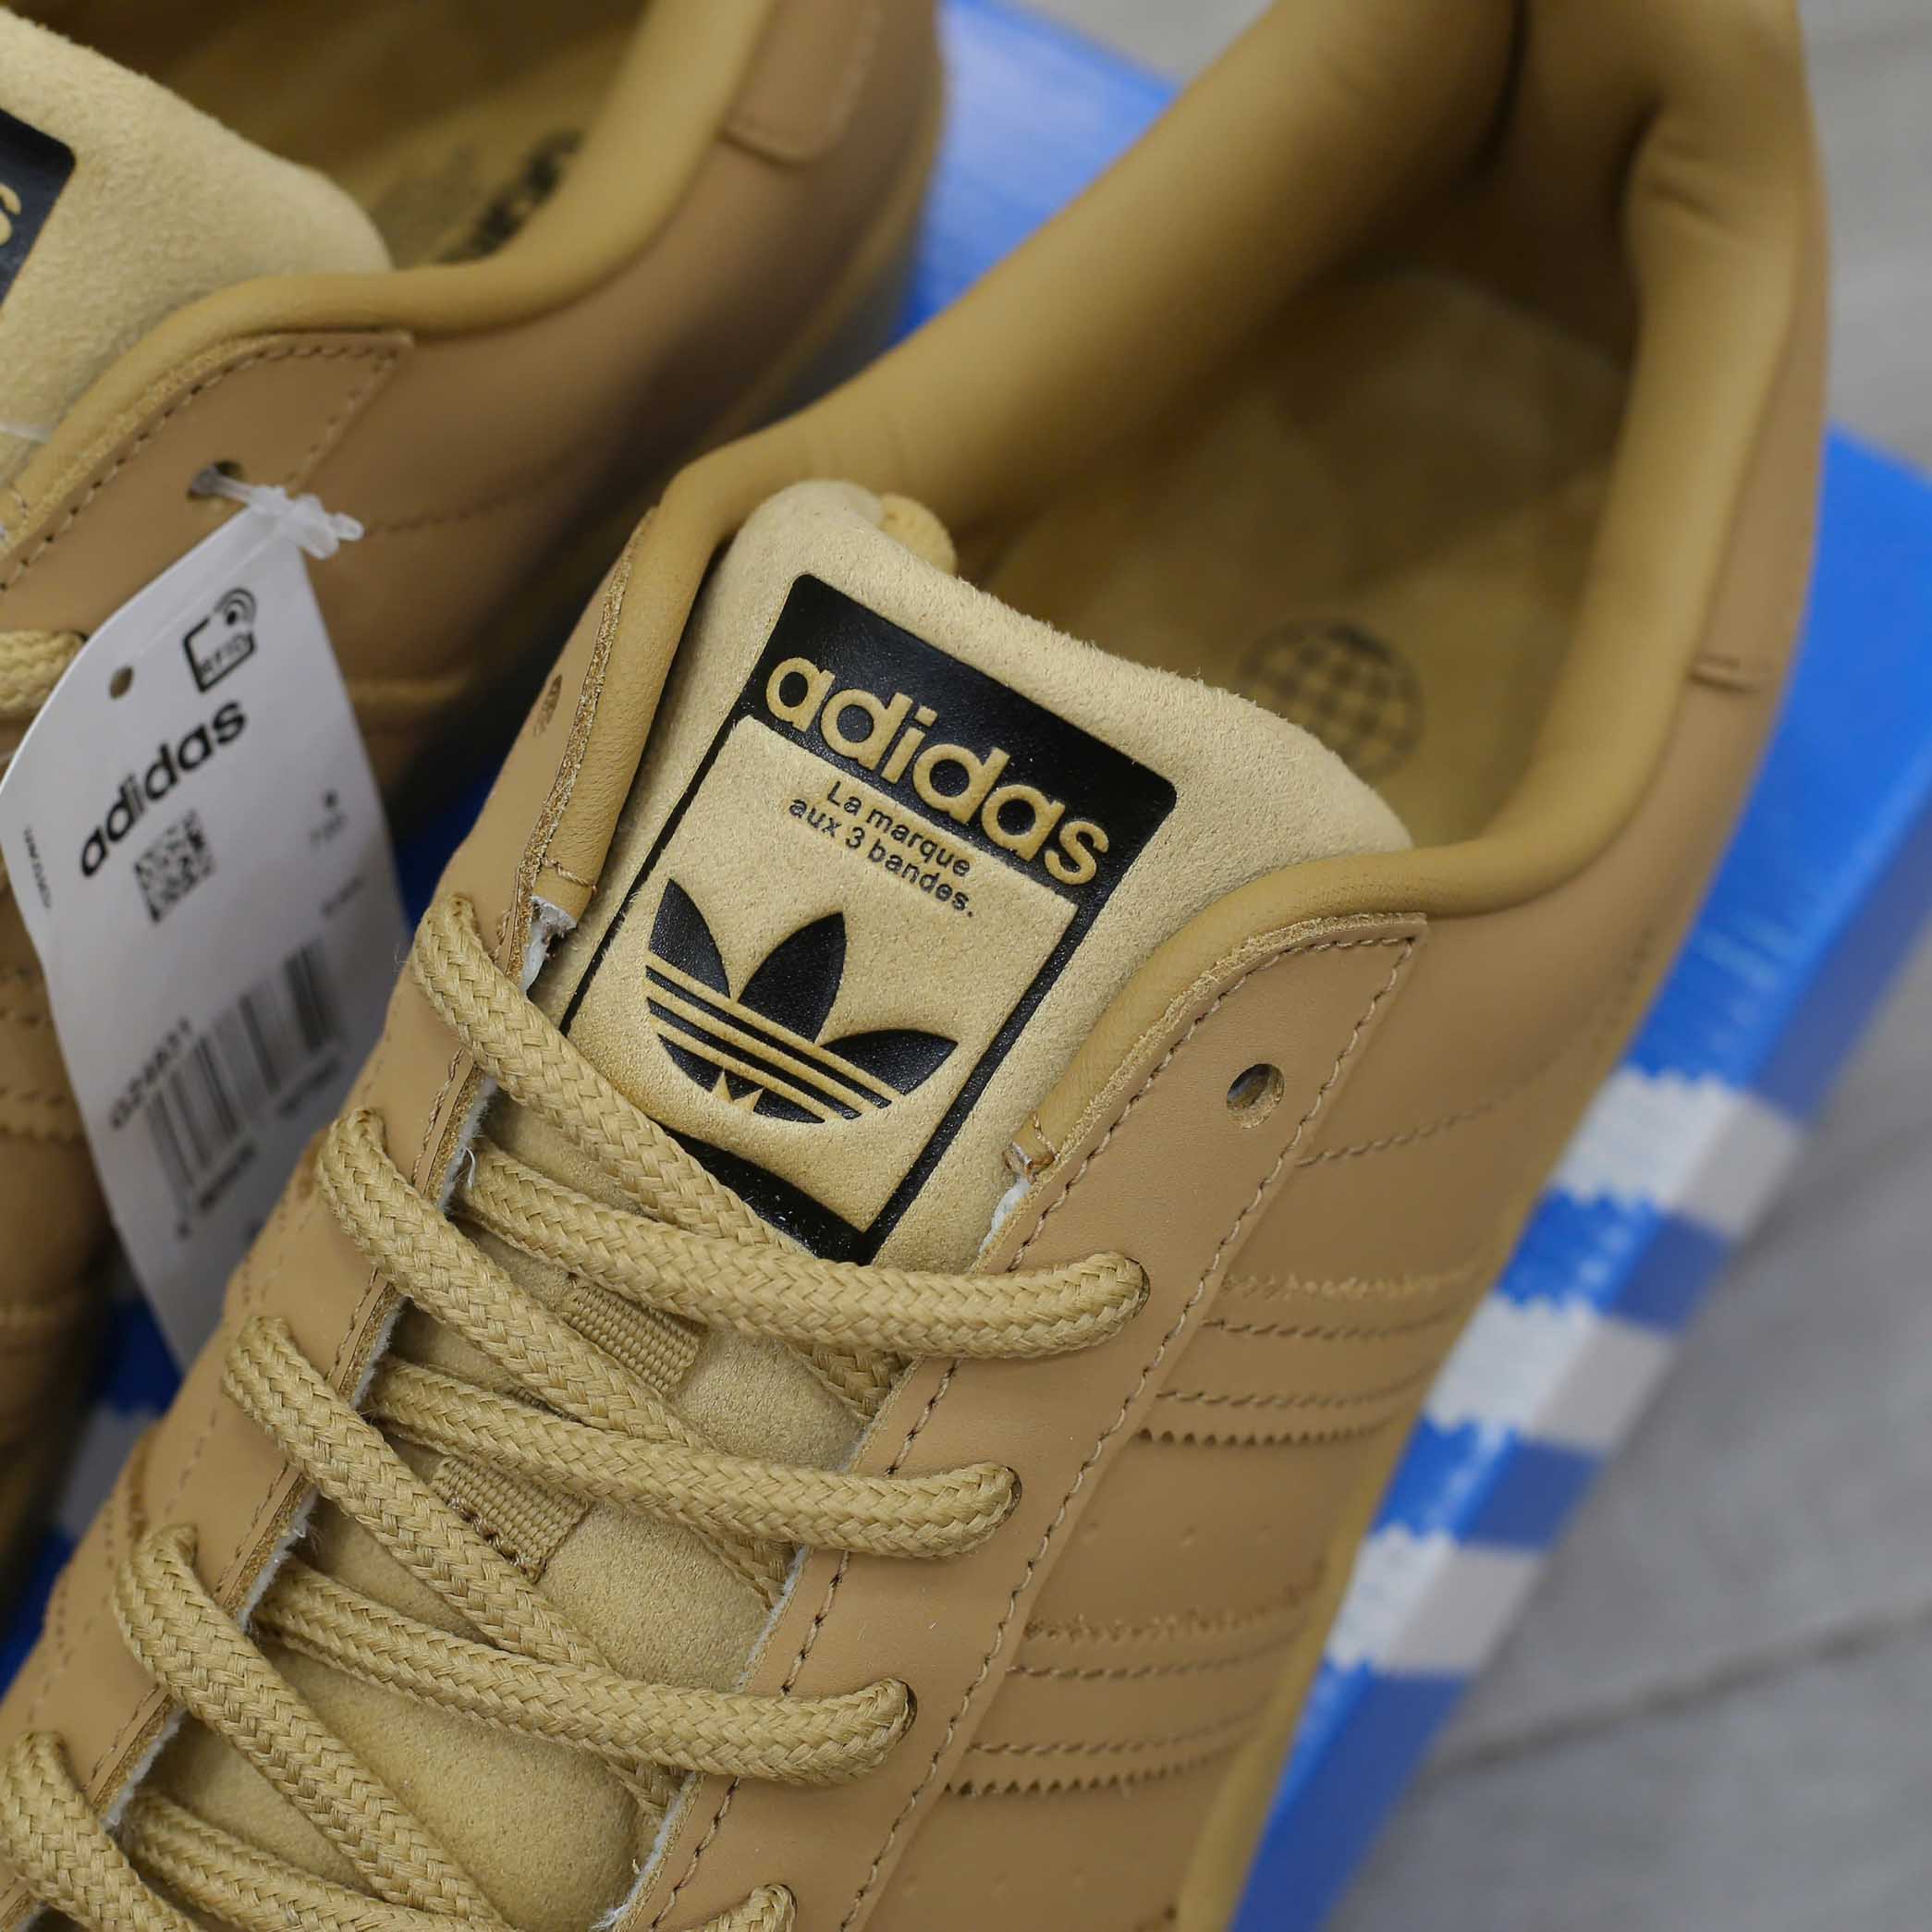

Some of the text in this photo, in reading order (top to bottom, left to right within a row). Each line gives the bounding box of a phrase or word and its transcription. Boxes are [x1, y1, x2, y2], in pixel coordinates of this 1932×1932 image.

[79, 700, 248, 877] adidas
[764, 656, 1110, 886] adidas
[826, 780, 971, 876] La marque
[789, 798, 973, 918] aux 3 bandes.
